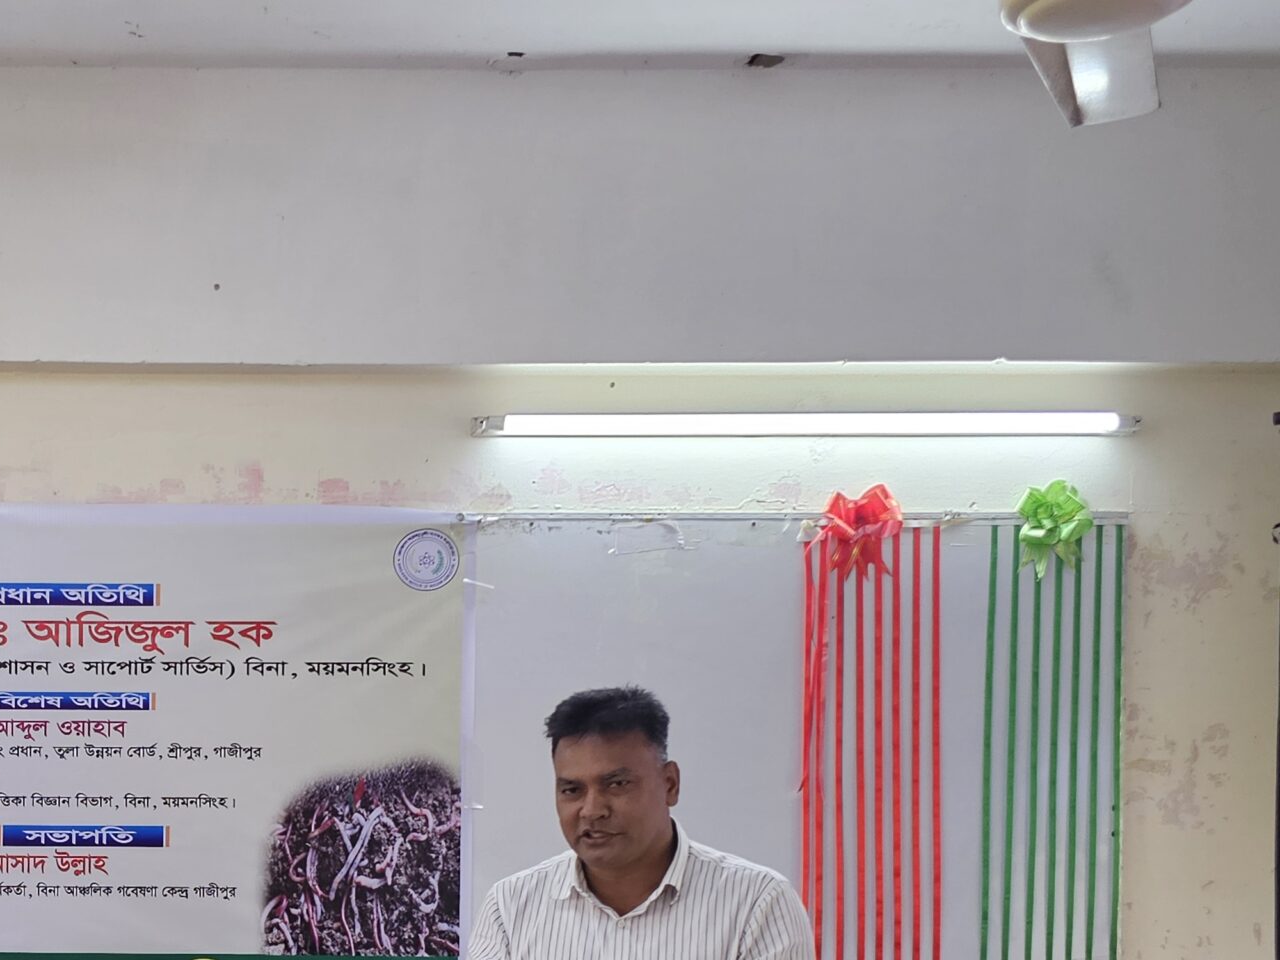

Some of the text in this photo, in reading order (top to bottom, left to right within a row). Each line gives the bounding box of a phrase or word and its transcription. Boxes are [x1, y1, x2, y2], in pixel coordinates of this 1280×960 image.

[60, 583, 148, 604] অতিথি
[21, 610, 195, 655] আজিজুল
[205, 619, 278, 650] হক
[59, 661, 75, 675] ও
[83, 656, 157, 677] সাপোর্ট
[161, 656, 236, 680] সার্ভিস)
[69, 692, 147, 709] অতিথি
[56, 719, 127, 738] ওয়াহাব
[9, 745, 49, 760] প্রধান,
[53, 745, 79, 760] তুলা
[84, 743, 122, 759] উন্নয়ন
[126, 743, 163, 760] বোর্ড,
[167, 742, 209, 760] শ্রীপুর,
[213, 743, 263, 761] গাজীপুর
[31, 792, 71, 808] বিজ্ঞান
[76, 792, 119, 811] বিভাগ,
[23, 827, 137, 845] সভাপতি
[53, 849, 110, 876] উল্লাহ
[37, 882, 59, 897] বিনা
[63, 882, 112, 898] আঞ্চলিক
[116, 884, 158, 898] গবেষণা
[161, 884, 189, 899] কেন্দ্র
[193, 882, 237, 900] গাজীপুর
